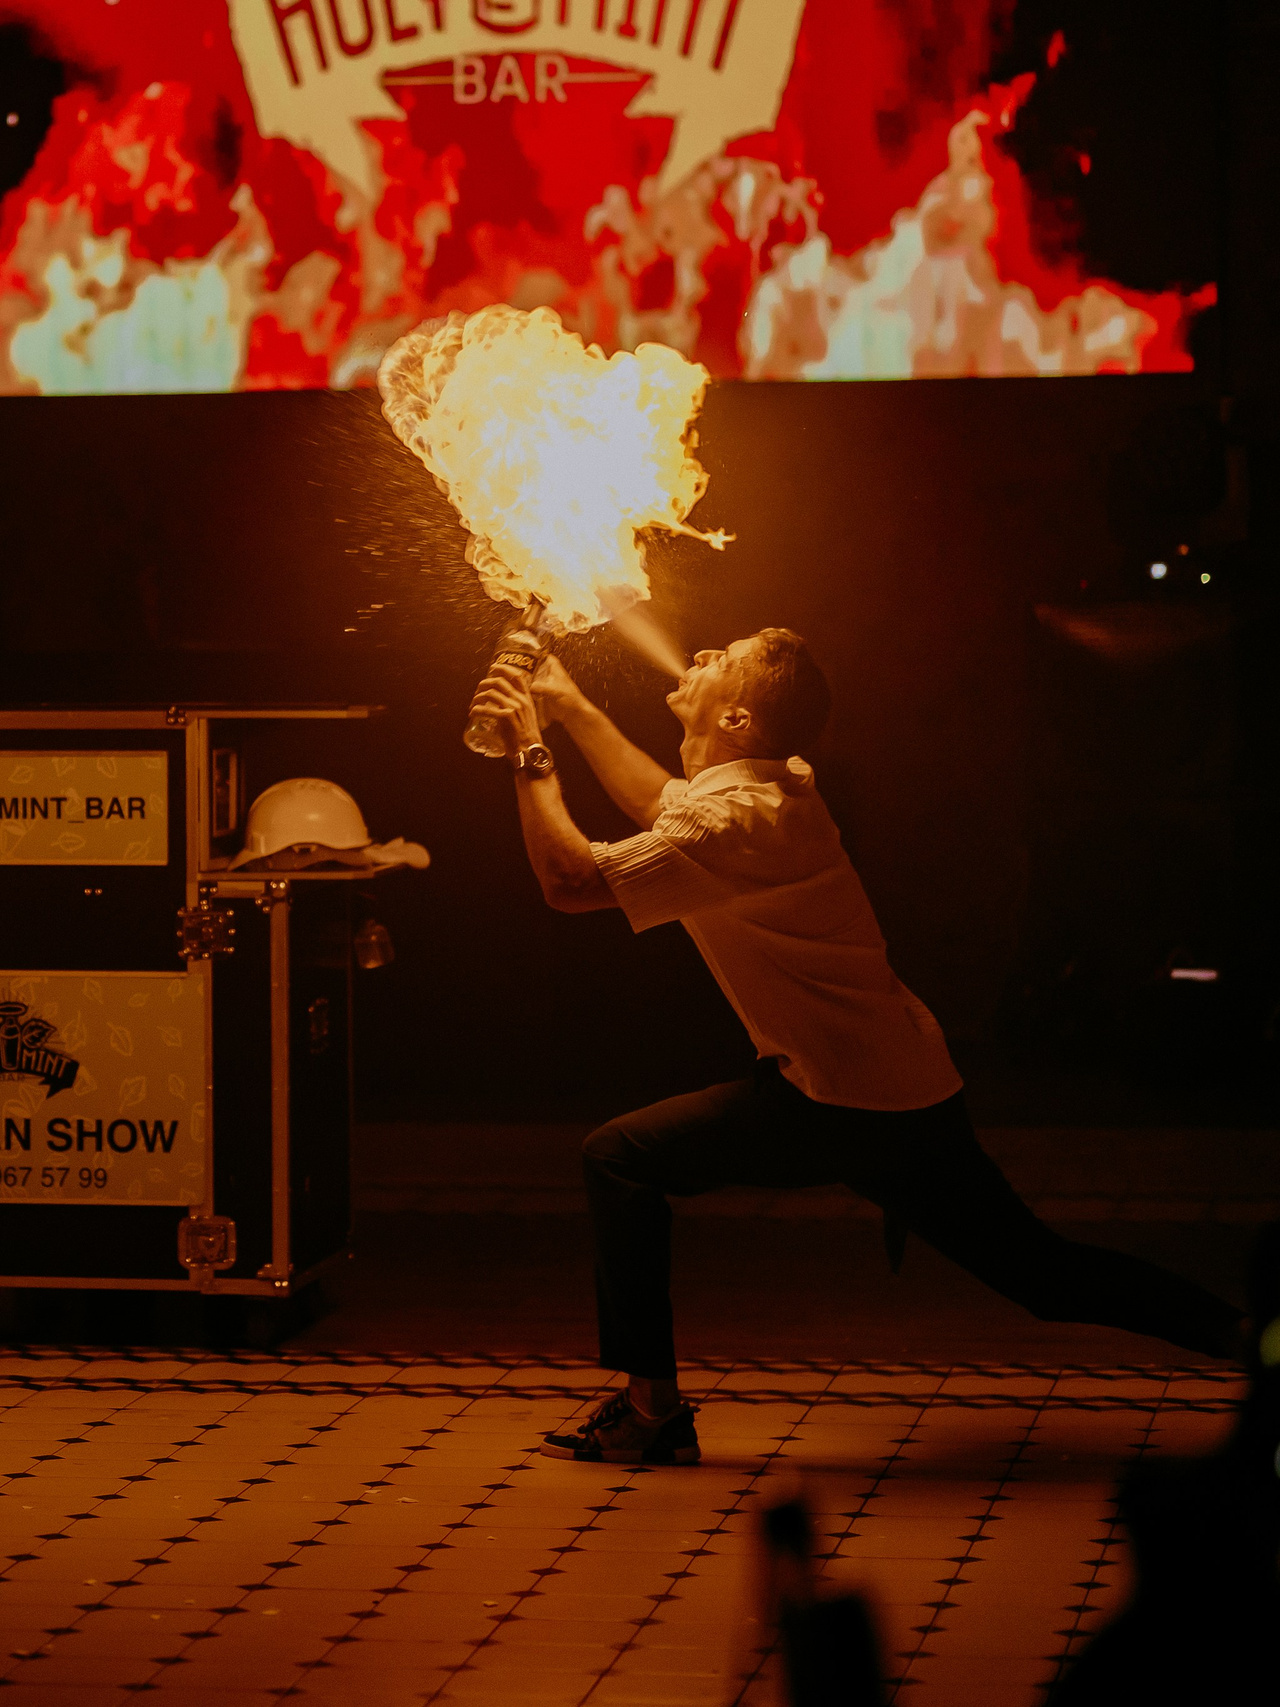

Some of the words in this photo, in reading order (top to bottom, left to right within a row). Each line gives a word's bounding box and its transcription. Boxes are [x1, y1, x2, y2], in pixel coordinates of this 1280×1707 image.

[453, 55, 568, 104] BAR
[22, 1048, 71, 1079] MINT
[46, 1117, 179, 1153] SHOW
[41, 1167, 70, 1188] 57
[78, 1168, 108, 1189] 99
